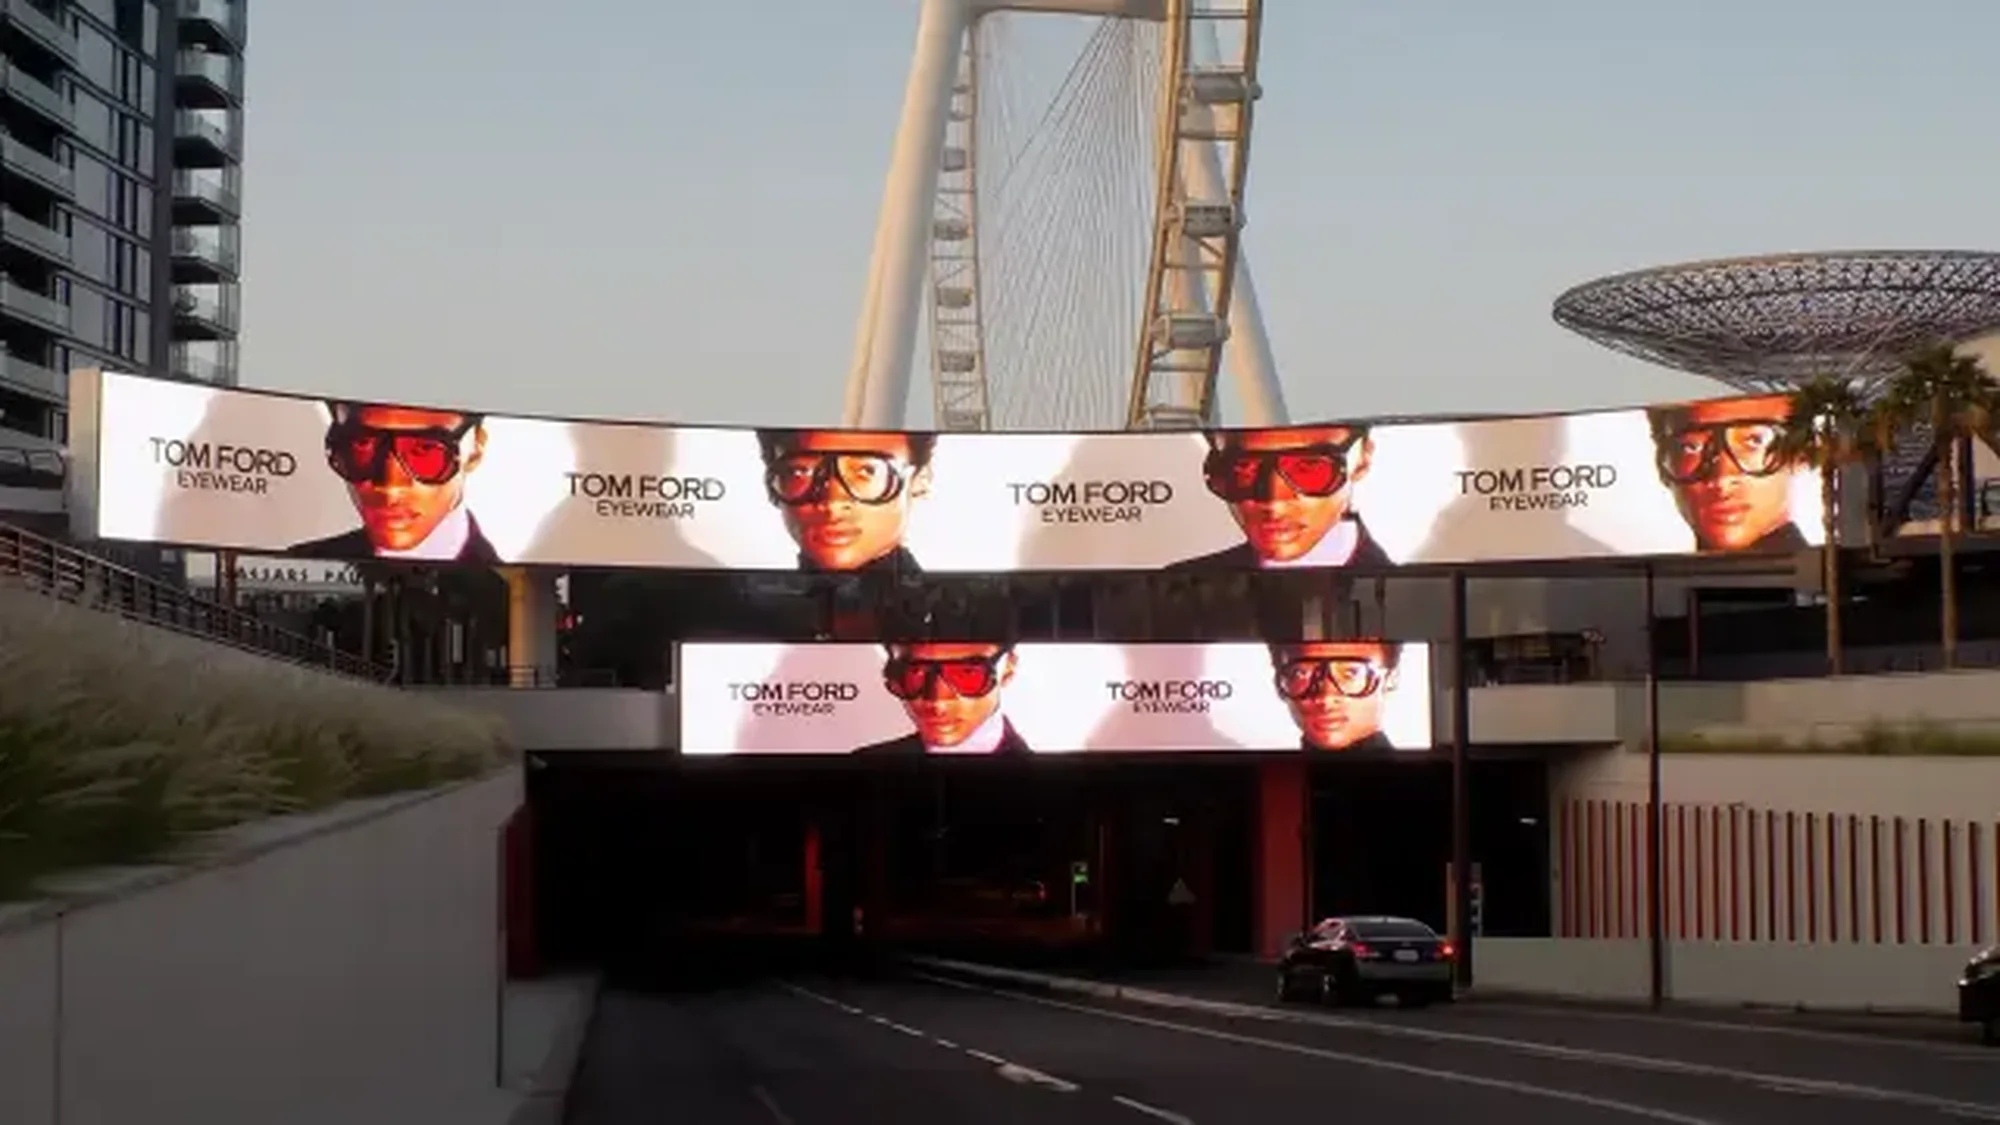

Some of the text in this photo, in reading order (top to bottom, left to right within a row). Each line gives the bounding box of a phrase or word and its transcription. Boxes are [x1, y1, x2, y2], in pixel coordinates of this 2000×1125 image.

[150, 437, 297, 477] TOM FORD
[177, 470, 268, 494] EYEWEAR
[564, 472, 726, 501] TOM FORD
[1454, 464, 1618, 495] TOM FORD
[1006, 481, 1174, 505] TOM FORD
[1489, 490, 1589, 511] EYEWEAR
[596, 501, 695, 519] EYEWEAR
[1041, 506, 1142, 523] EYEWEAR
[728, 682, 860, 701] TOM FORD
[1105, 680, 1233, 701] TOM FORD
[752, 702, 836, 717] EYEWEAR
[1132, 701, 1211, 714] EYEWEAR
